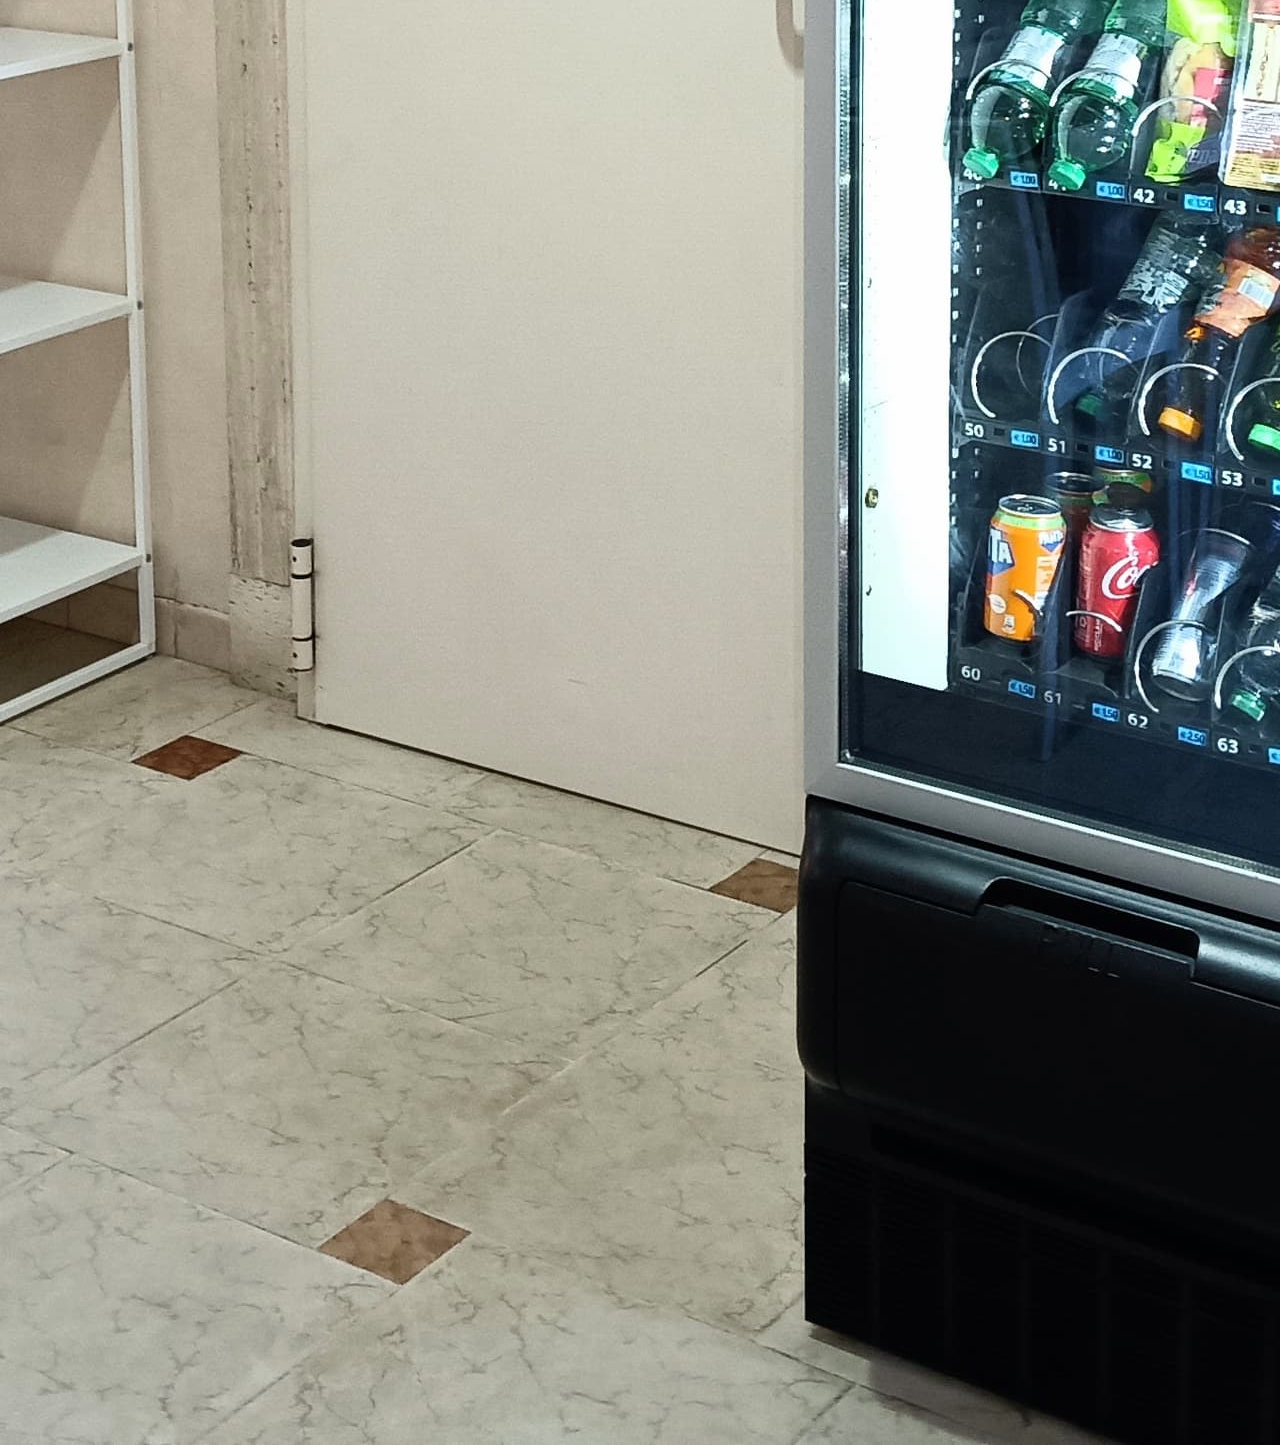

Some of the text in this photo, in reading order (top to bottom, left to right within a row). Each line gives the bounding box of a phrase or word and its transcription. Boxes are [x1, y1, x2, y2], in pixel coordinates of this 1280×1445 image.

[1133, 188, 1155, 204] 42
[1224, 199, 1247, 215] 43
[964, 422, 985, 439] 50
[1047, 438, 1066, 453] 51
[1131, 453, 1153, 470] 52
[1221, 470, 1243, 487] 53
[961, 664, 981, 681] 60
[1043, 689, 1062, 706] 61
[1127, 713, 1149, 729] 62
[1217, 737, 1239, 754] 63
